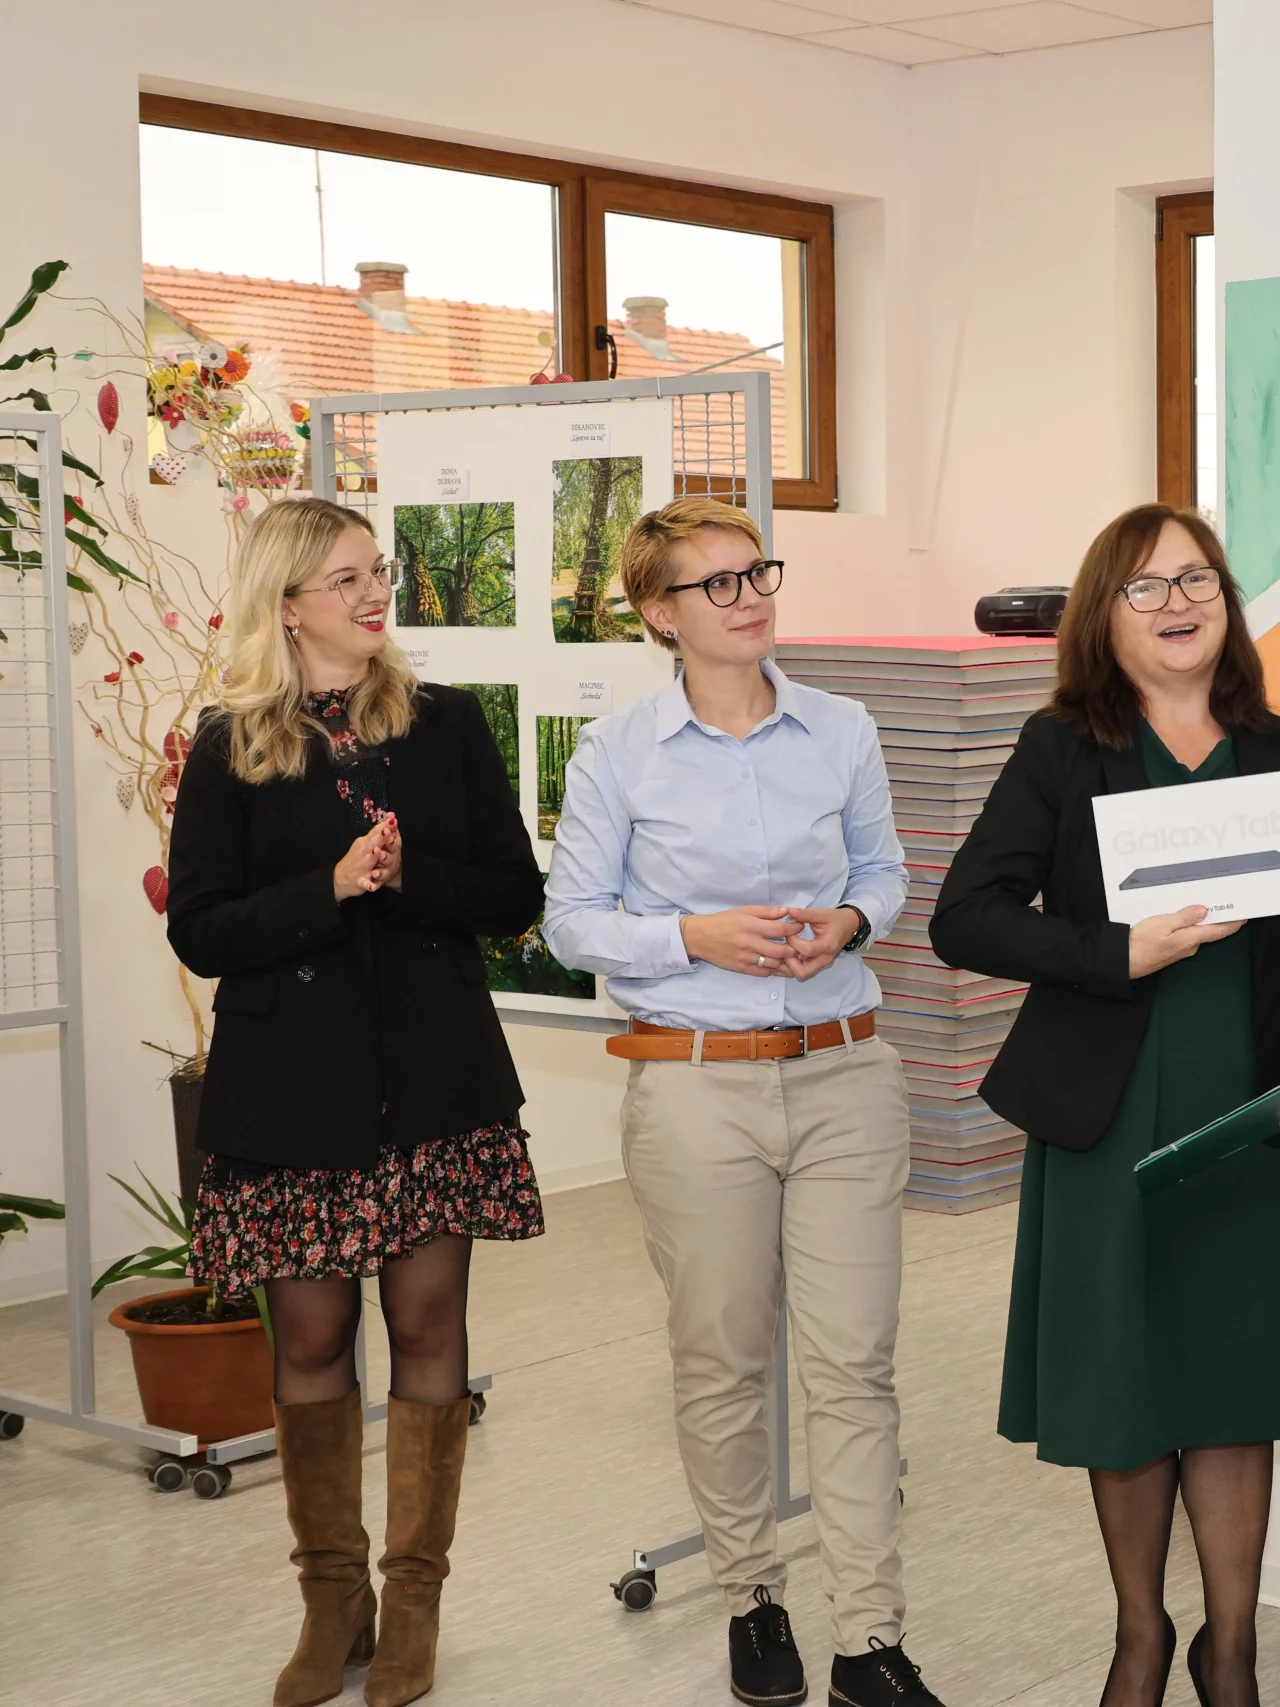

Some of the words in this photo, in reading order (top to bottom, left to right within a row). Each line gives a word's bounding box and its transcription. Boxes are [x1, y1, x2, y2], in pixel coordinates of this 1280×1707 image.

[441, 468, 458, 476] DONJA
[437, 477, 462, 485] DUBRAVA
[1112, 822, 1228, 855] Galaxy
